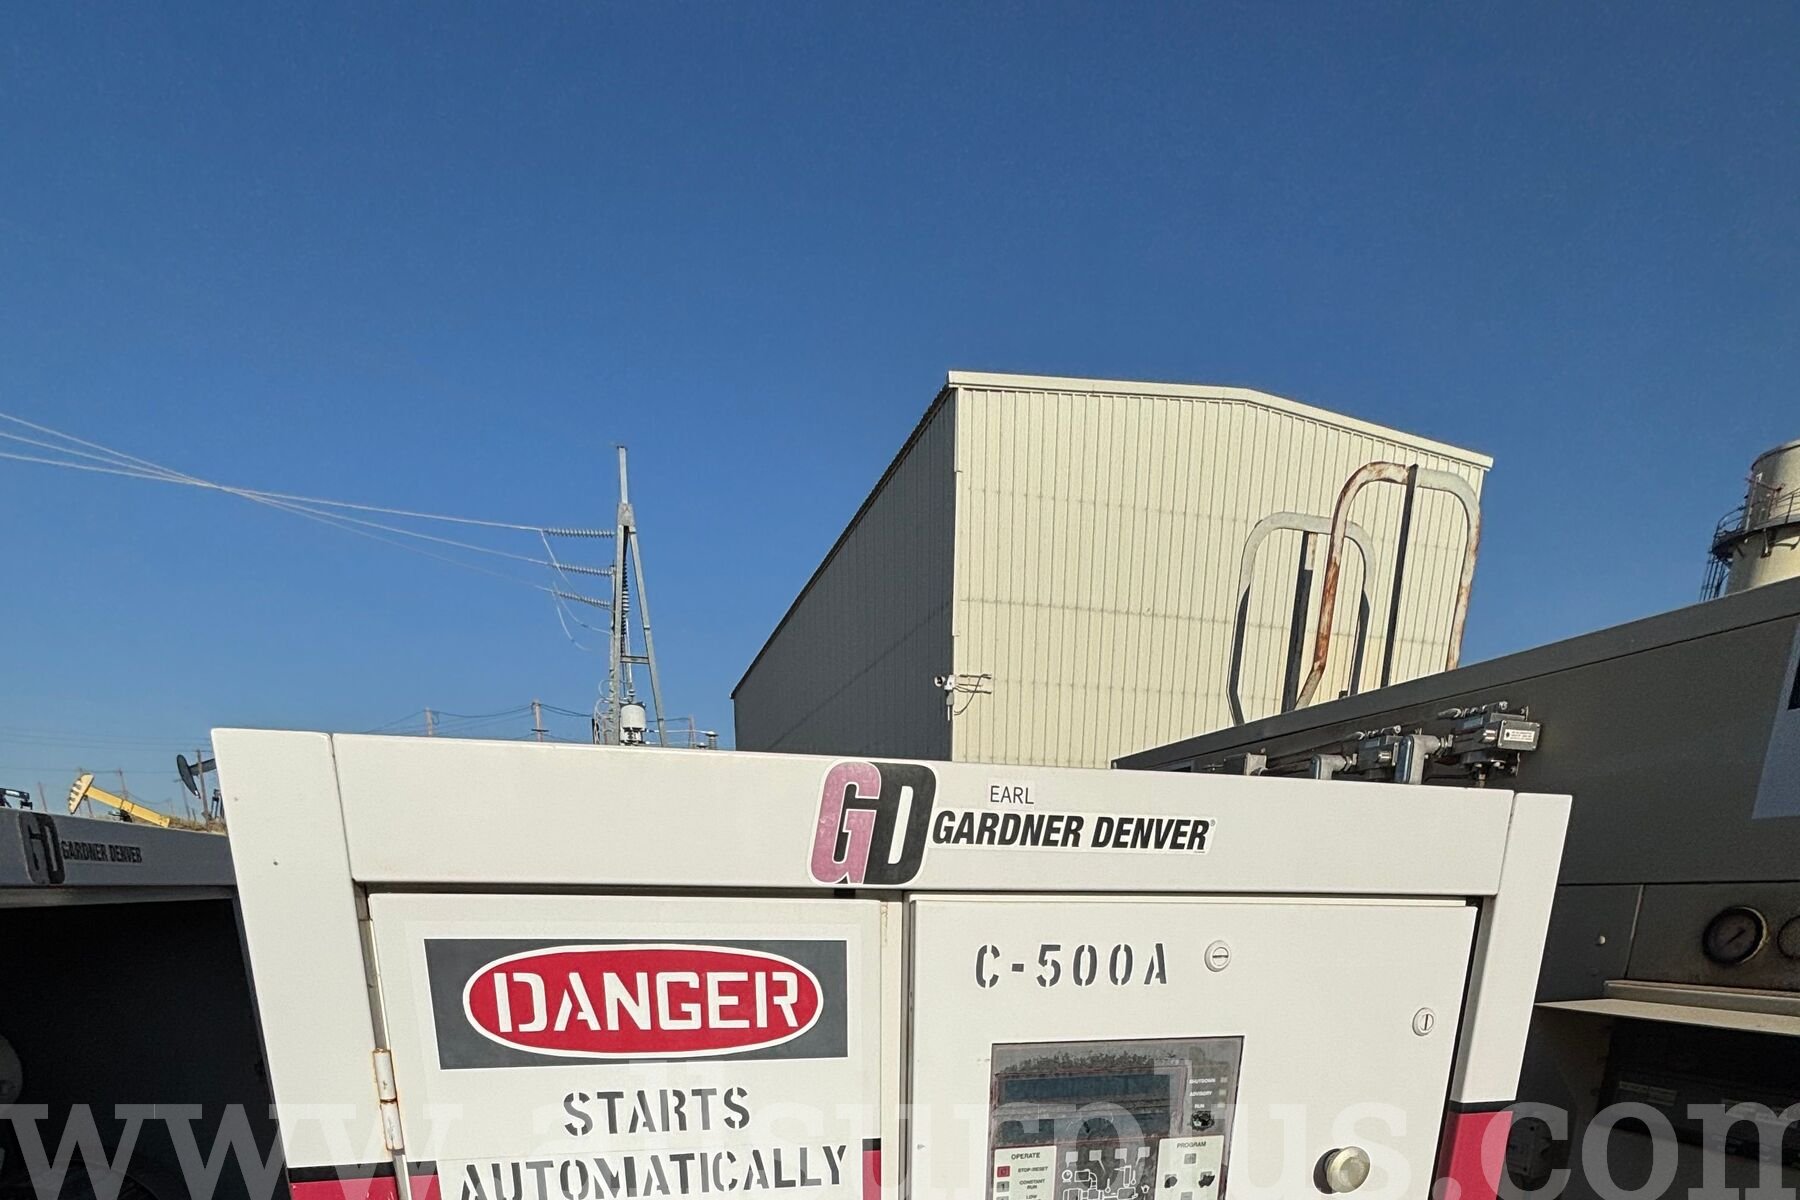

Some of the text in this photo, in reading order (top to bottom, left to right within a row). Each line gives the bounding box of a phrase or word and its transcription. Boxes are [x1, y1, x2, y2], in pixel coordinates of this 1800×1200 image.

[989, 784, 1034, 806] EARL
[931, 811, 1084, 848] GARDNER
[61, 840, 142, 864] GARDNER DENVER
[974, 942, 1168, 989] C-500A
[493, 971, 800, 1034] DANGER
[563, 1086, 750, 1136] STARTS
[1011, 1152, 1041, 1160] OPERATE
[1176, 1141, 1207, 1149] PROGRAM
